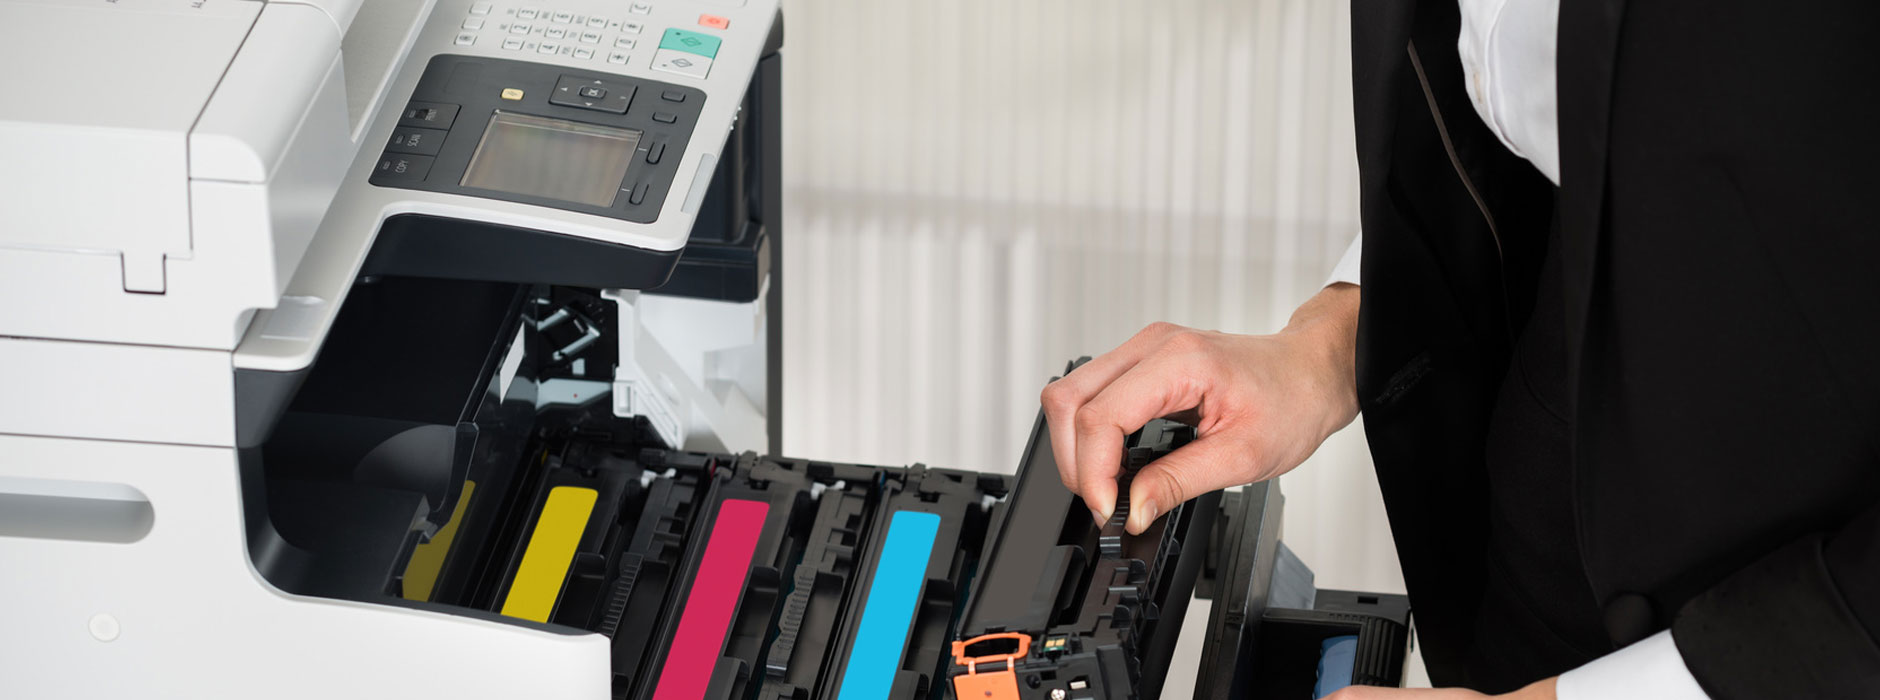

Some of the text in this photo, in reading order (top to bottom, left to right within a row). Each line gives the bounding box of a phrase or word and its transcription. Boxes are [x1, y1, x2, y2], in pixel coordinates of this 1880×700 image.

[588, 88, 599, 97] OK
[407, 134, 421, 147] SCAN
[395, 160, 408, 173] COPY
